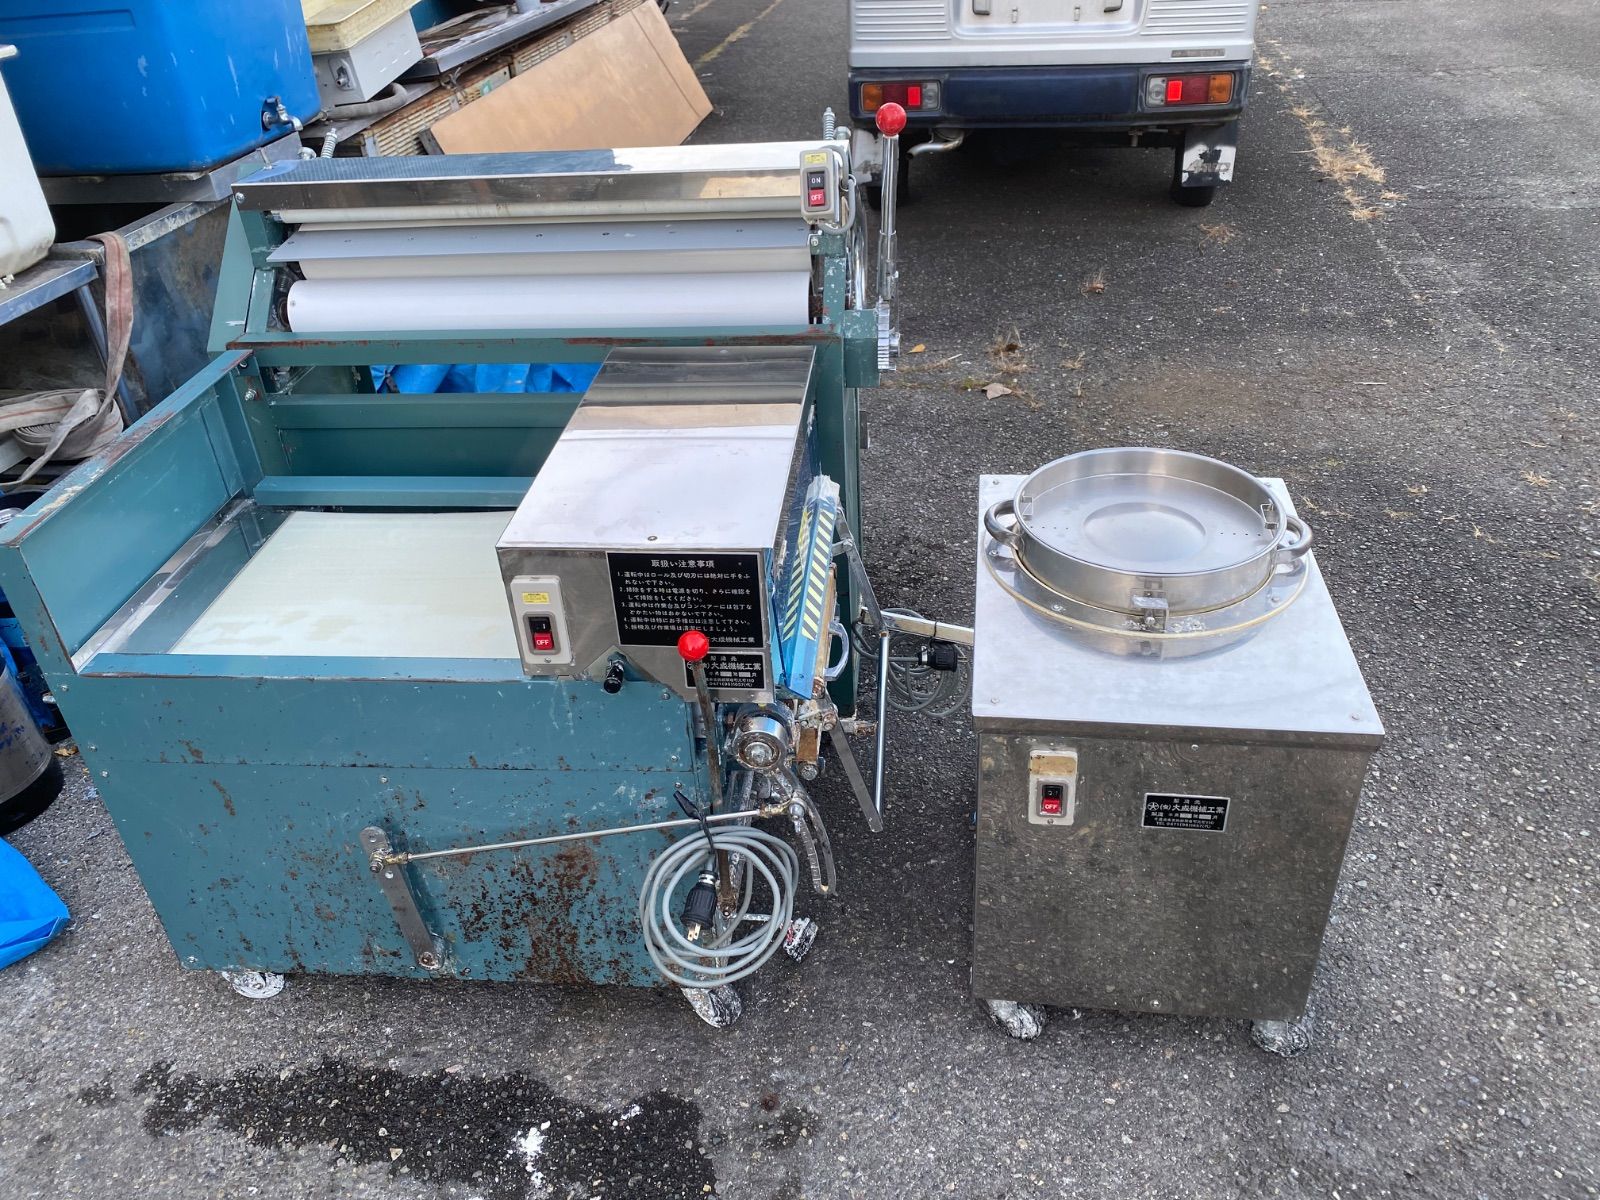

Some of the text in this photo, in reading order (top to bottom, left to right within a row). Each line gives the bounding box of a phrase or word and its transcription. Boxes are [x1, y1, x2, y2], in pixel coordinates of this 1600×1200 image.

[811, 193, 824, 201] OFF
[651, 559, 715, 568] 取扱い注意事項
[702, 661, 761, 671] )大成機械工業
